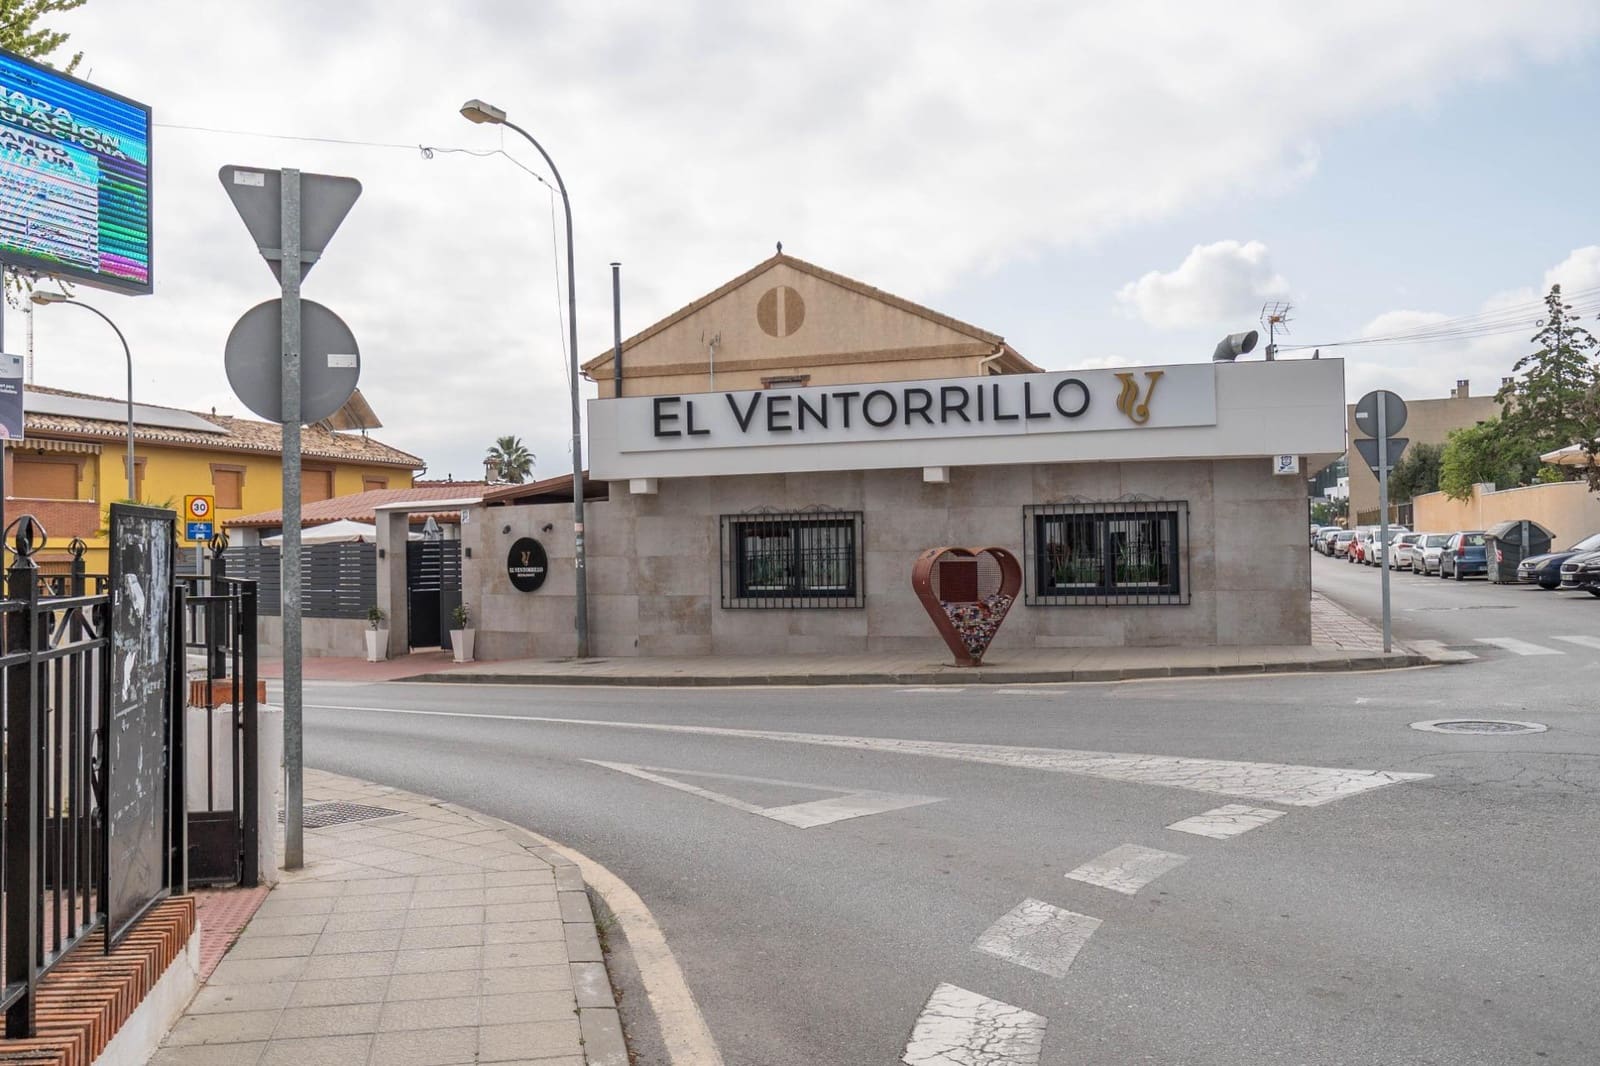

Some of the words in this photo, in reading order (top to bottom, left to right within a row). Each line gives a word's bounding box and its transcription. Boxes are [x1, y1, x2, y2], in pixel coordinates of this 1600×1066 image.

[653, 396, 710, 438] EL
[725, 377, 1091, 433] VENTORRILLO
[193, 503, 206, 512] 30
